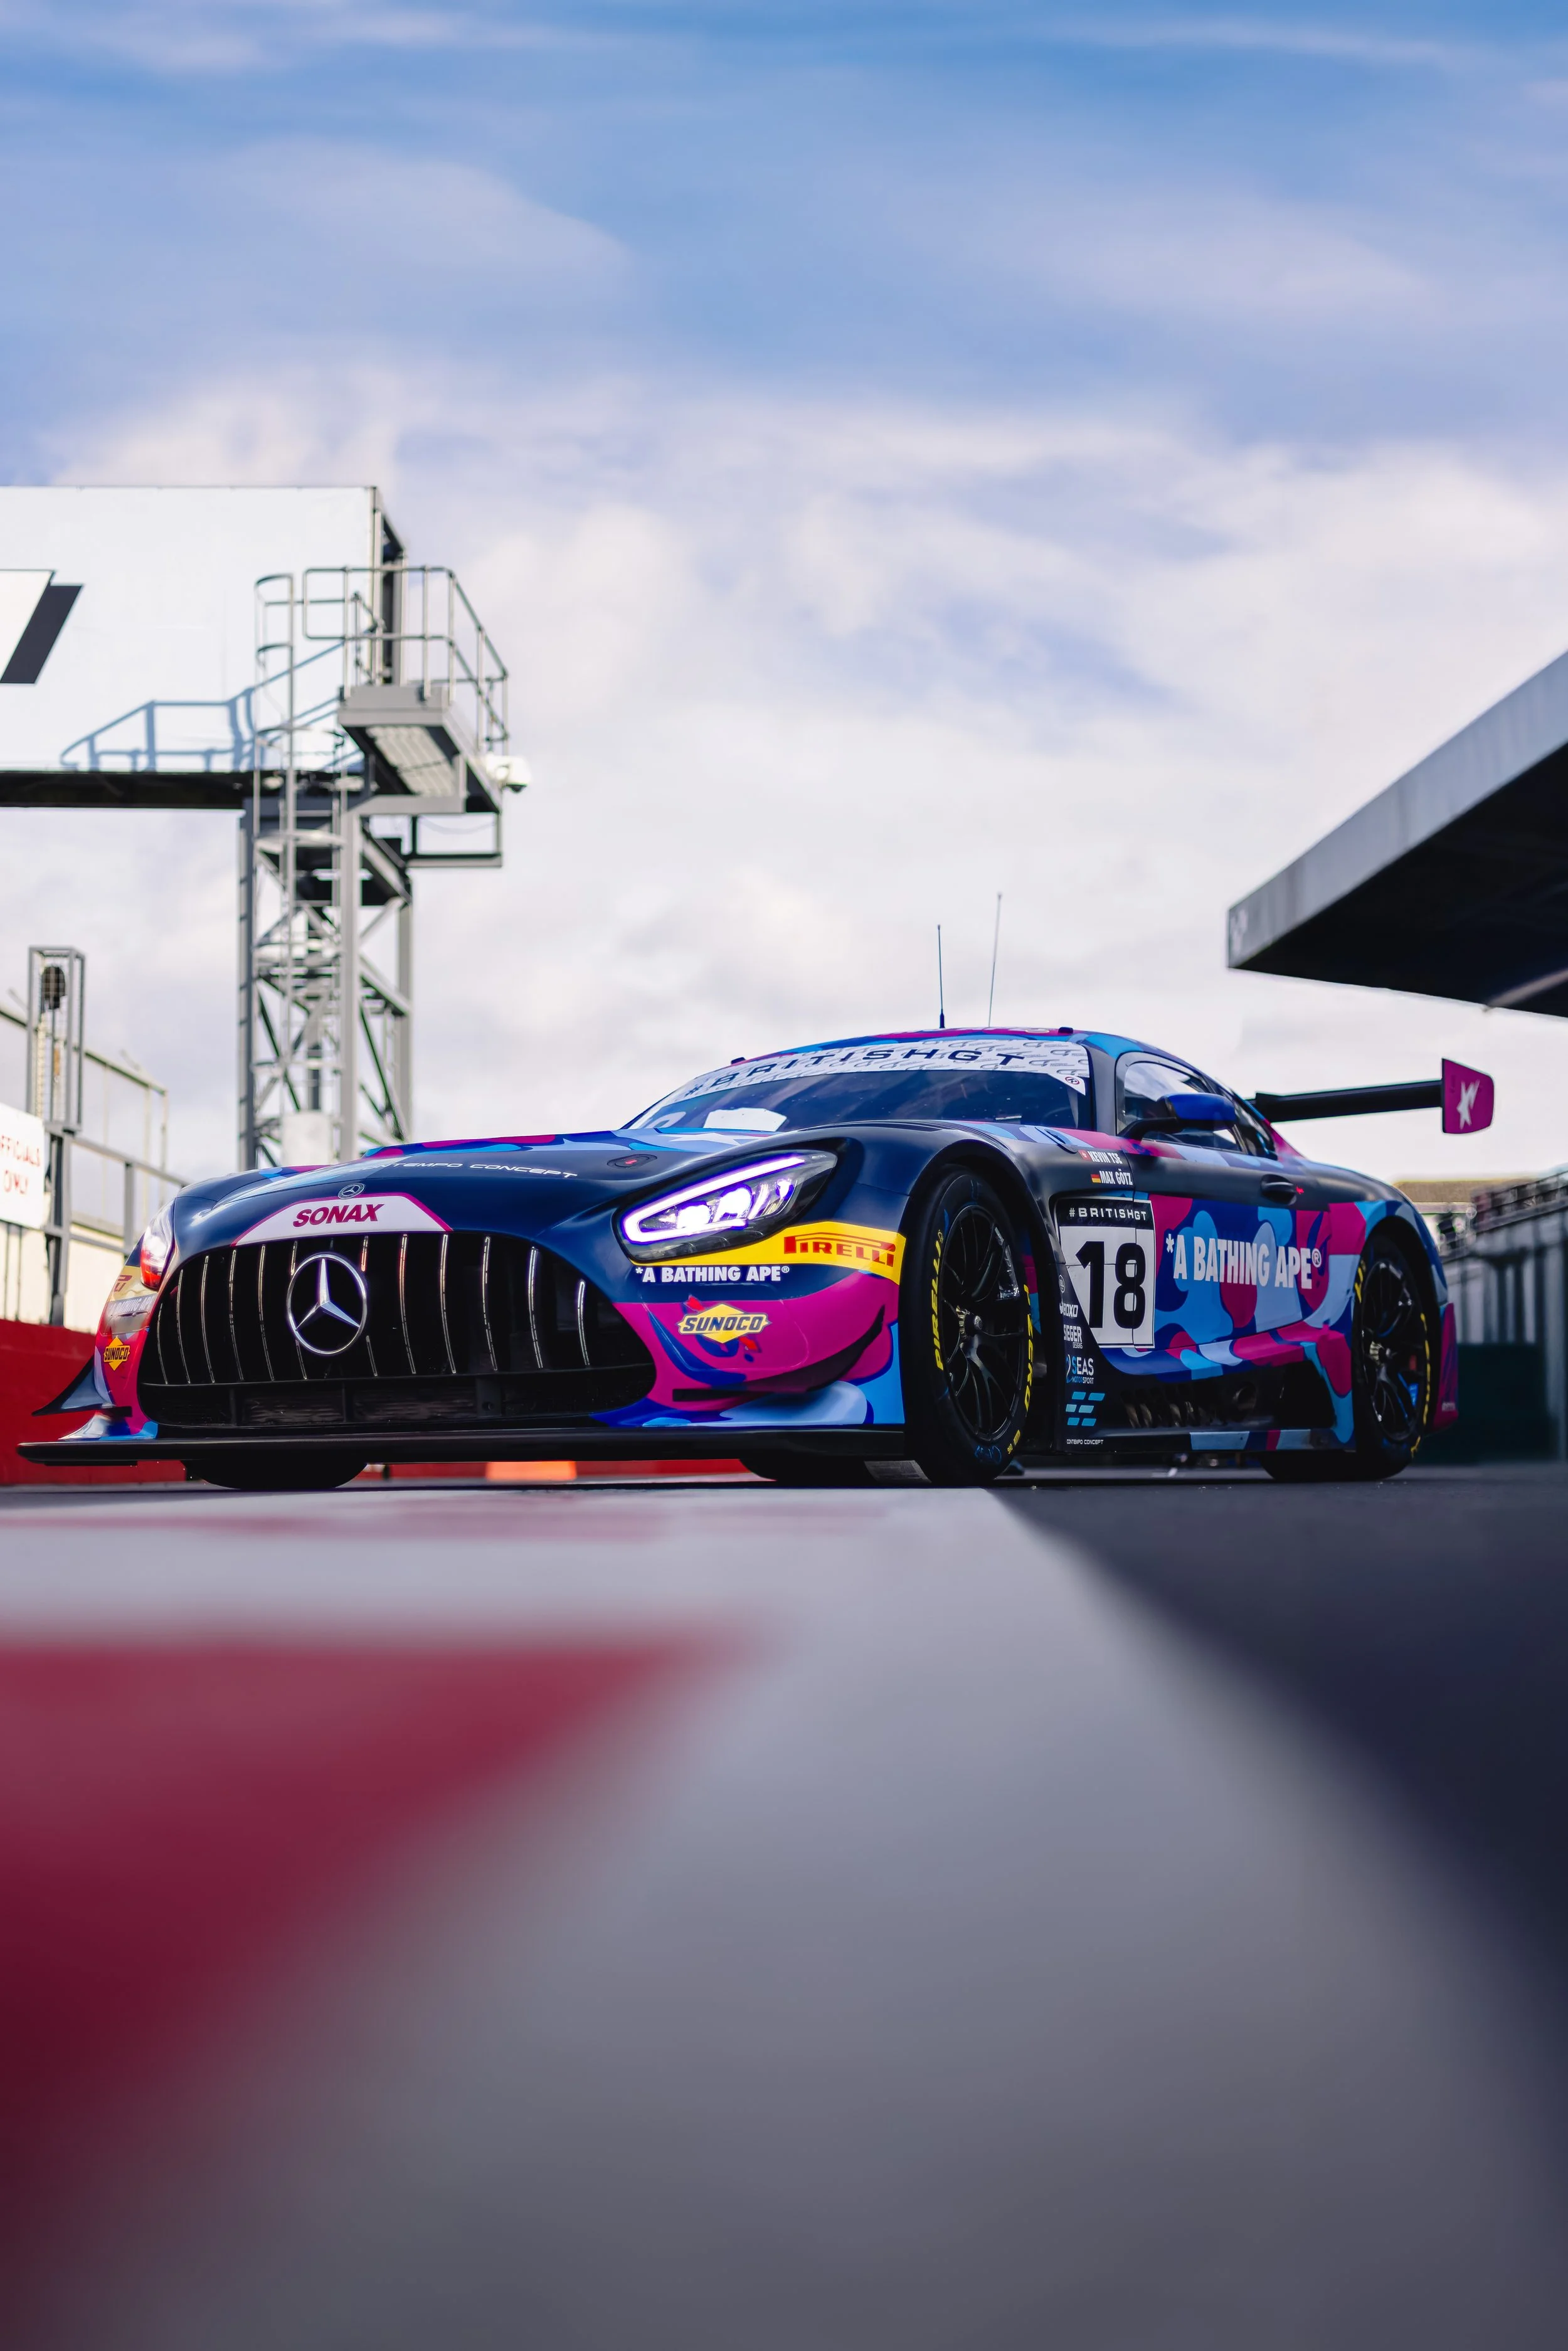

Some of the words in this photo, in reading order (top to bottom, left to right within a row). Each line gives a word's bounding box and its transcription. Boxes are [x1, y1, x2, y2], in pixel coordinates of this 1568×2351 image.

[685, 1048, 1025, 1097] #BRITISHGT
[0, 1134, 41, 1167] FFICIALS
[1088, 1151, 1110, 1163] KEVIN
[1108, 1152, 1123, 1164] TSE
[349, 1162, 463, 1172] ONTEMPO
[469, 1164, 578, 1178] CONCEPT
[1099, 1170, 1115, 1184] MAX
[1116, 1169, 1133, 1186] GÖTZ
[293, 1204, 384, 1228] SONAX
[1069, 1207, 1147, 1221] #BRITISHGT
[783, 1232, 896, 1268] PIRELLI
[1194, 1236, 1269, 1287] BATHING
[662, 1266, 741, 1283] BATHING
[1076, 1241, 1146, 1329] 18
[931, 1240, 943, 1371] PIRELLI
[682, 1315, 763, 1332] SUNOCO
[104, 1346, 129, 1361] SUNOCO
[1072, 1356, 1094, 1376] SEAS
